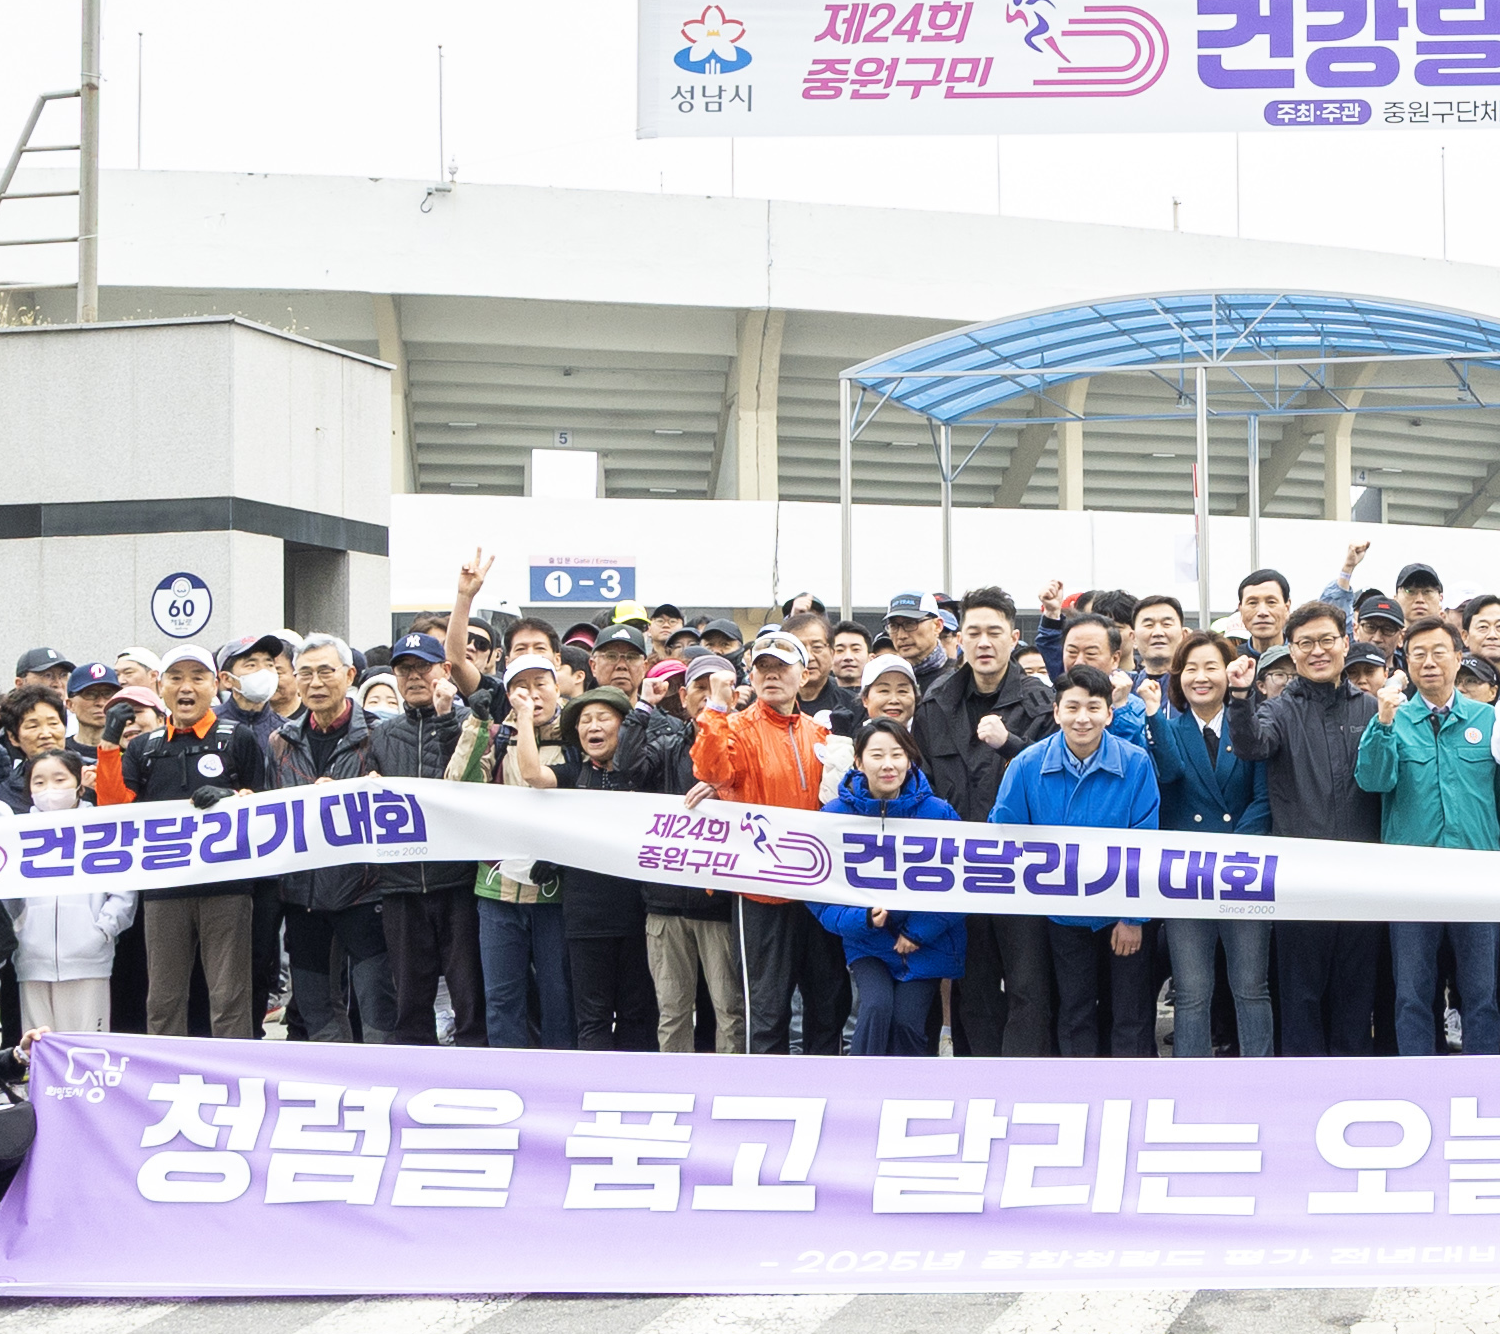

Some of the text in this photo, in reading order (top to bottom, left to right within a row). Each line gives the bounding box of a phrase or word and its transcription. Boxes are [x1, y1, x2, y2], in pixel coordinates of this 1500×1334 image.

[813, 0, 975, 46] 제24회
[800, 55, 993, 101] 중원구민
[670, 83, 754, 114] 성남시
[1275, 101, 1363, 125] 주최·주관
[558, 431, 568, 445] 5
[168, 598, 195, 618] 60
[18, 791, 429, 879] 건강달리기 대회
[644, 813, 731, 845] 제24회
[376, 845, 428, 857] Since 2000
[637, 845, 739, 877] 중원구민
[843, 832, 1279, 903] 건강달리기 대회
[1218, 903, 1276, 915] Since 2000
[44, 1085, 85, 1101] 희망도시
[136, 1073, 526, 1210] 청렴을
[563, 1091, 828, 1213] 품고
[872, 1096, 1263, 1216] 달리는
[790, 1249, 967, 1274] 2025년
[1223, 1248, 1315, 1266] 평가
